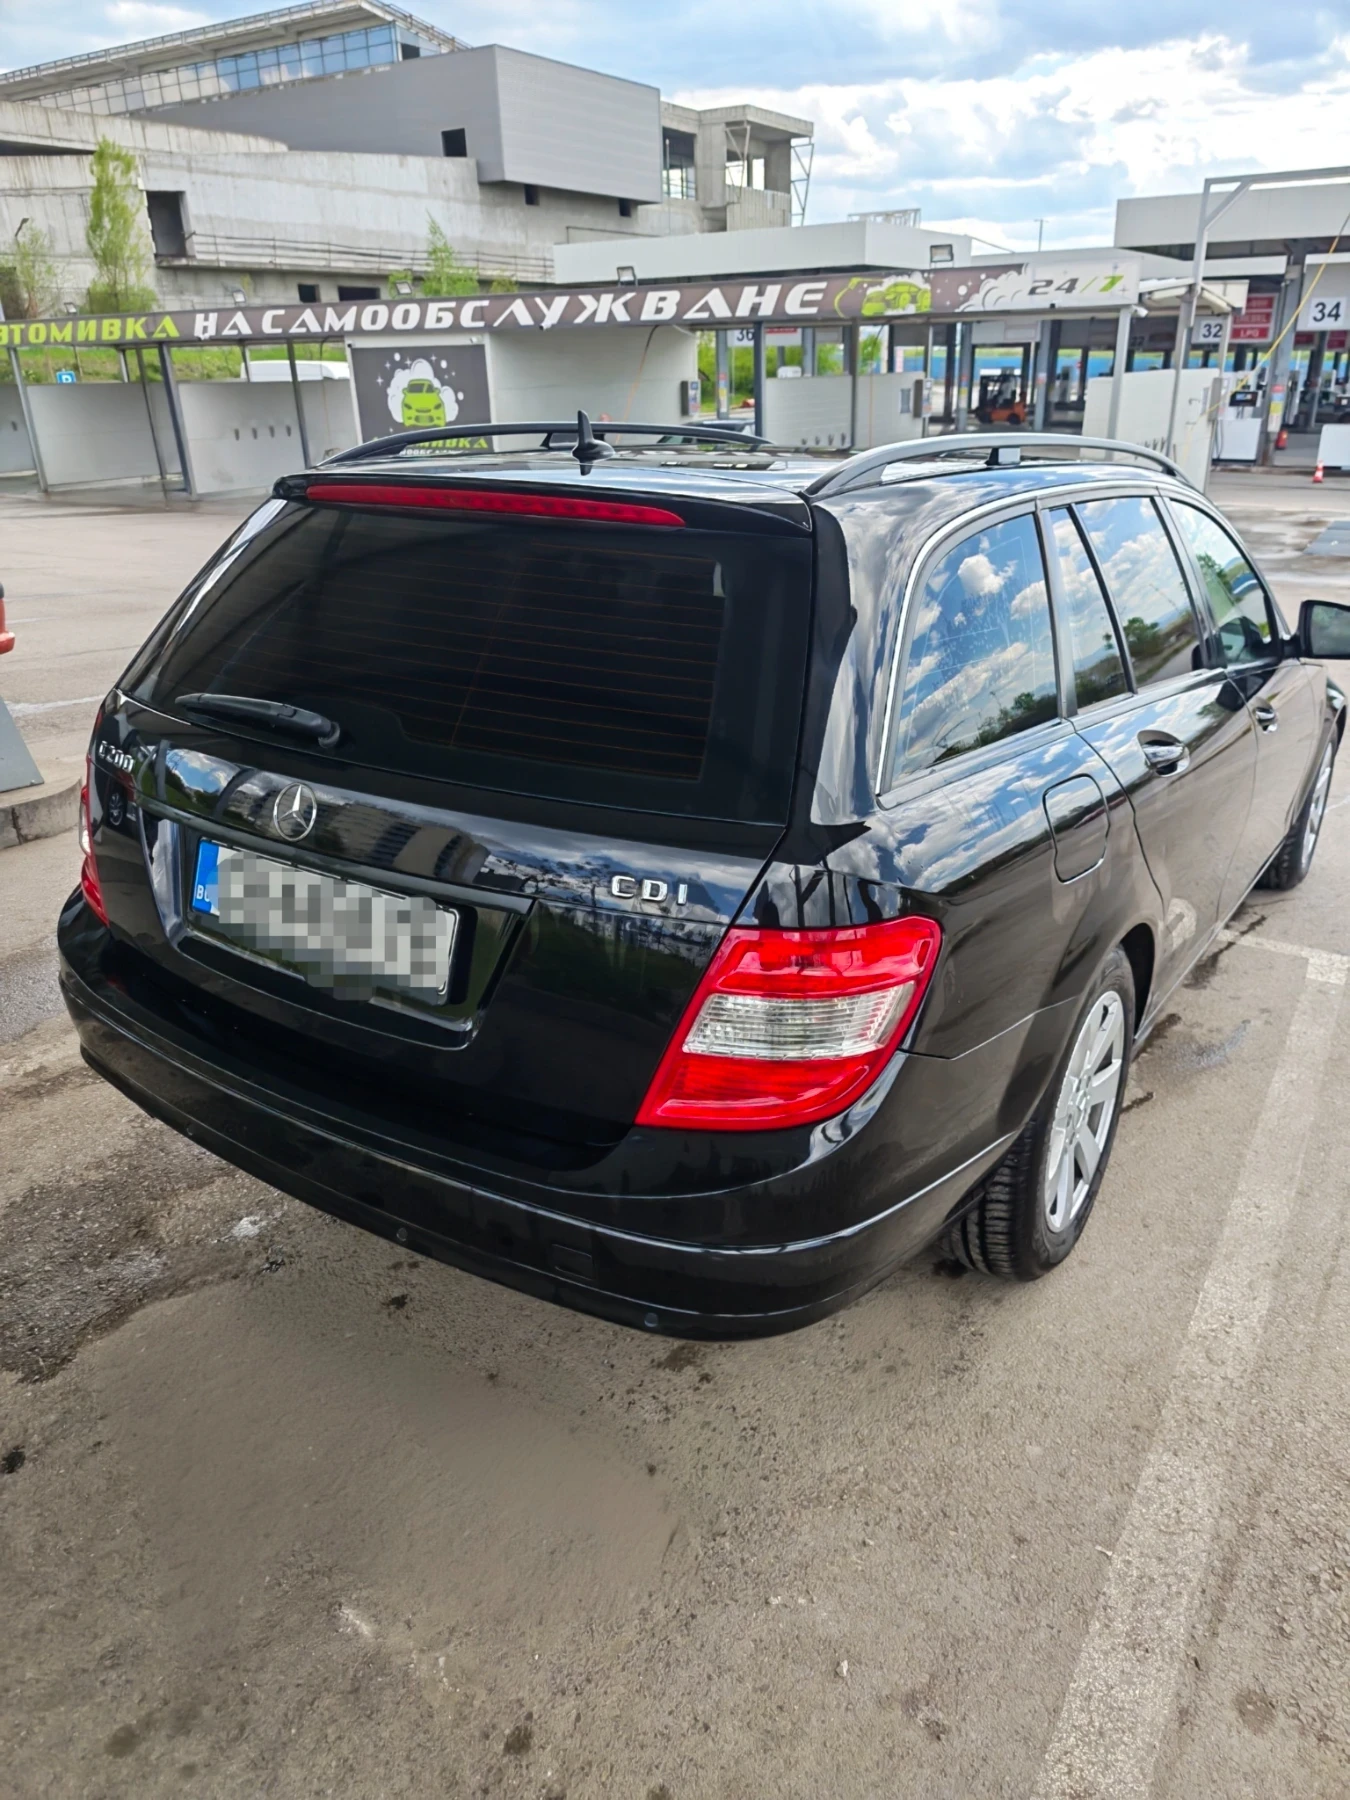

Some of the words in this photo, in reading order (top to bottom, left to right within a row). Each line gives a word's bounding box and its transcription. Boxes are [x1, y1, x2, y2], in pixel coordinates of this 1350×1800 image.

[1027, 275, 1124, 296] 24/7
[1312, 301, 1341, 322] 34
[736, 328, 755, 342] 36
[1202, 323, 1223, 339] 32
[611, 874, 688, 905] CDI
